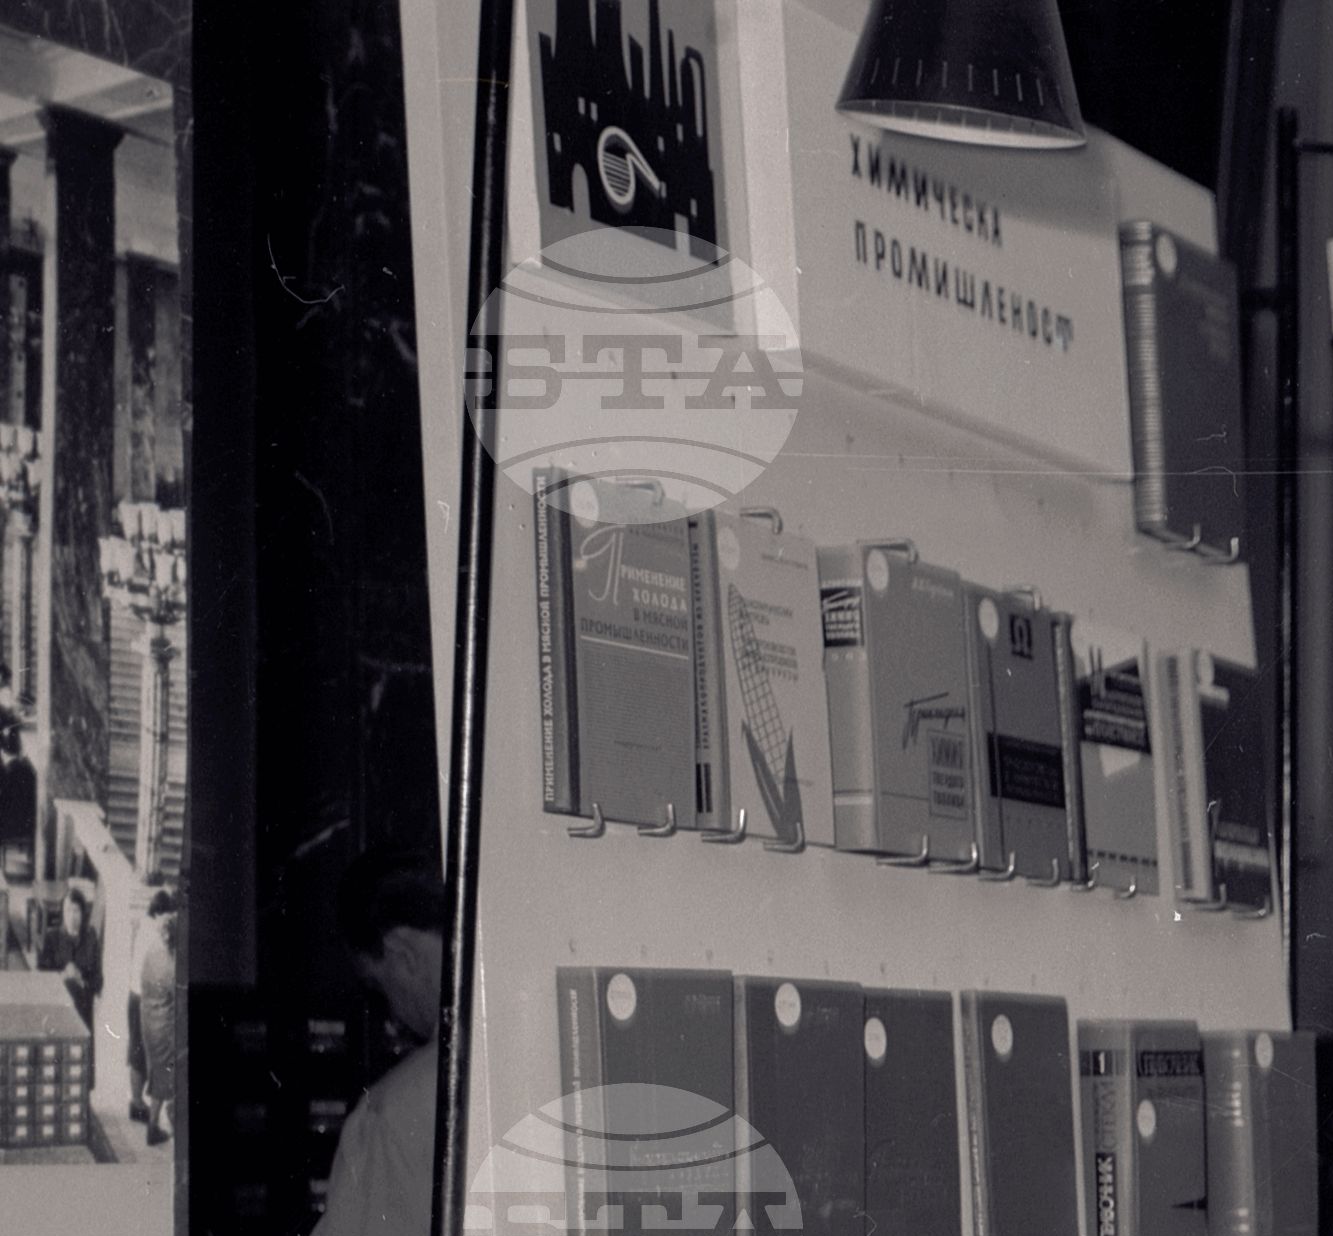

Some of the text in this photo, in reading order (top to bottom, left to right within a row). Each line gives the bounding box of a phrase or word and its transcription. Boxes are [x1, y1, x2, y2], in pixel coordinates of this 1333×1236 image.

[849, 133, 1003, 247] ХИМИЧЕСКА
[854, 219, 1075, 353] ПРОМИШЛЕНОСТ
[632, 588, 687, 612] ХОЛОДА
